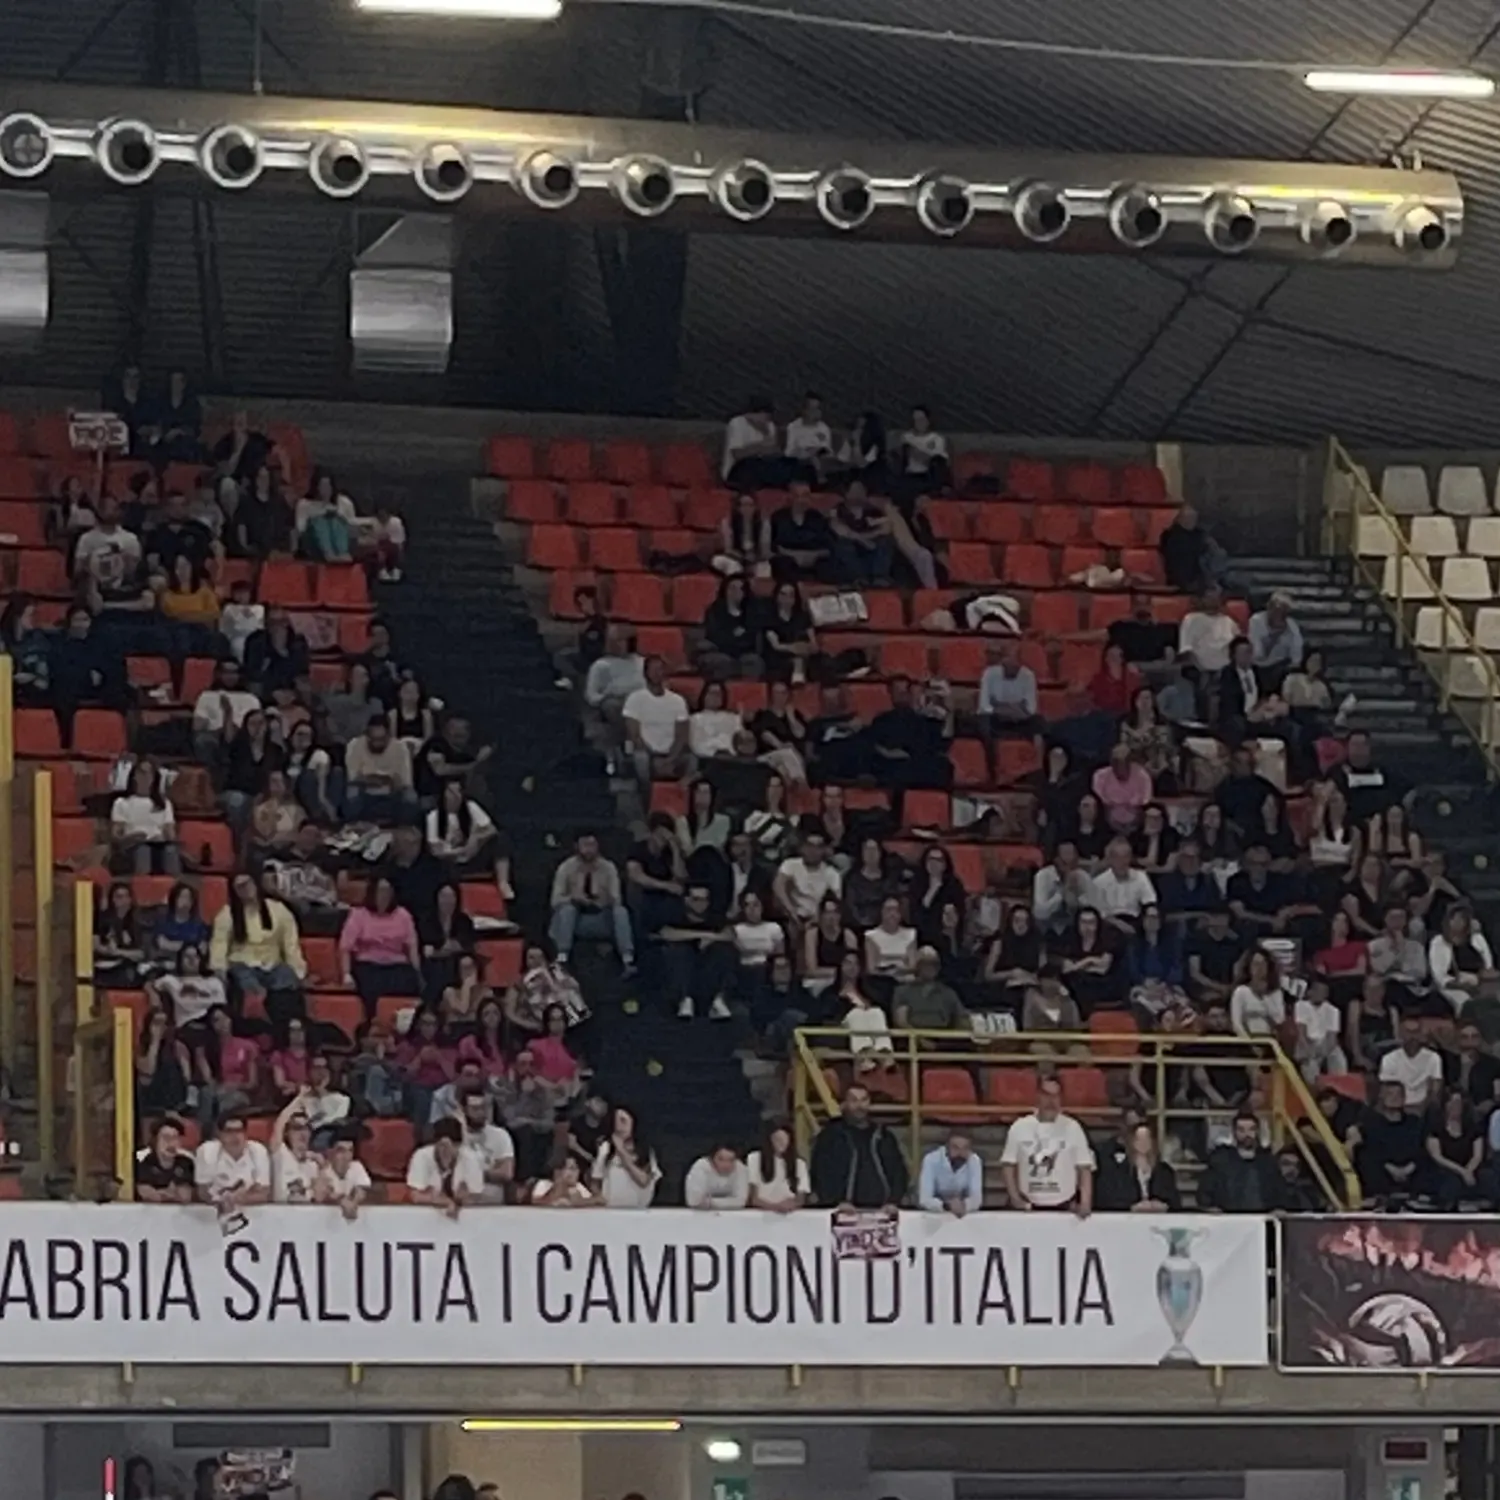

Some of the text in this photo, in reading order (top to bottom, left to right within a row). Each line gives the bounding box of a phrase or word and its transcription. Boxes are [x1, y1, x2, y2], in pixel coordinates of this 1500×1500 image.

[223, 1240, 479, 1324] SALUTA
[502, 1244, 512, 1323] I
[536, 1243, 842, 1325] CAMPIONI
[865, 1246, 1115, 1326] D'ITALIA
